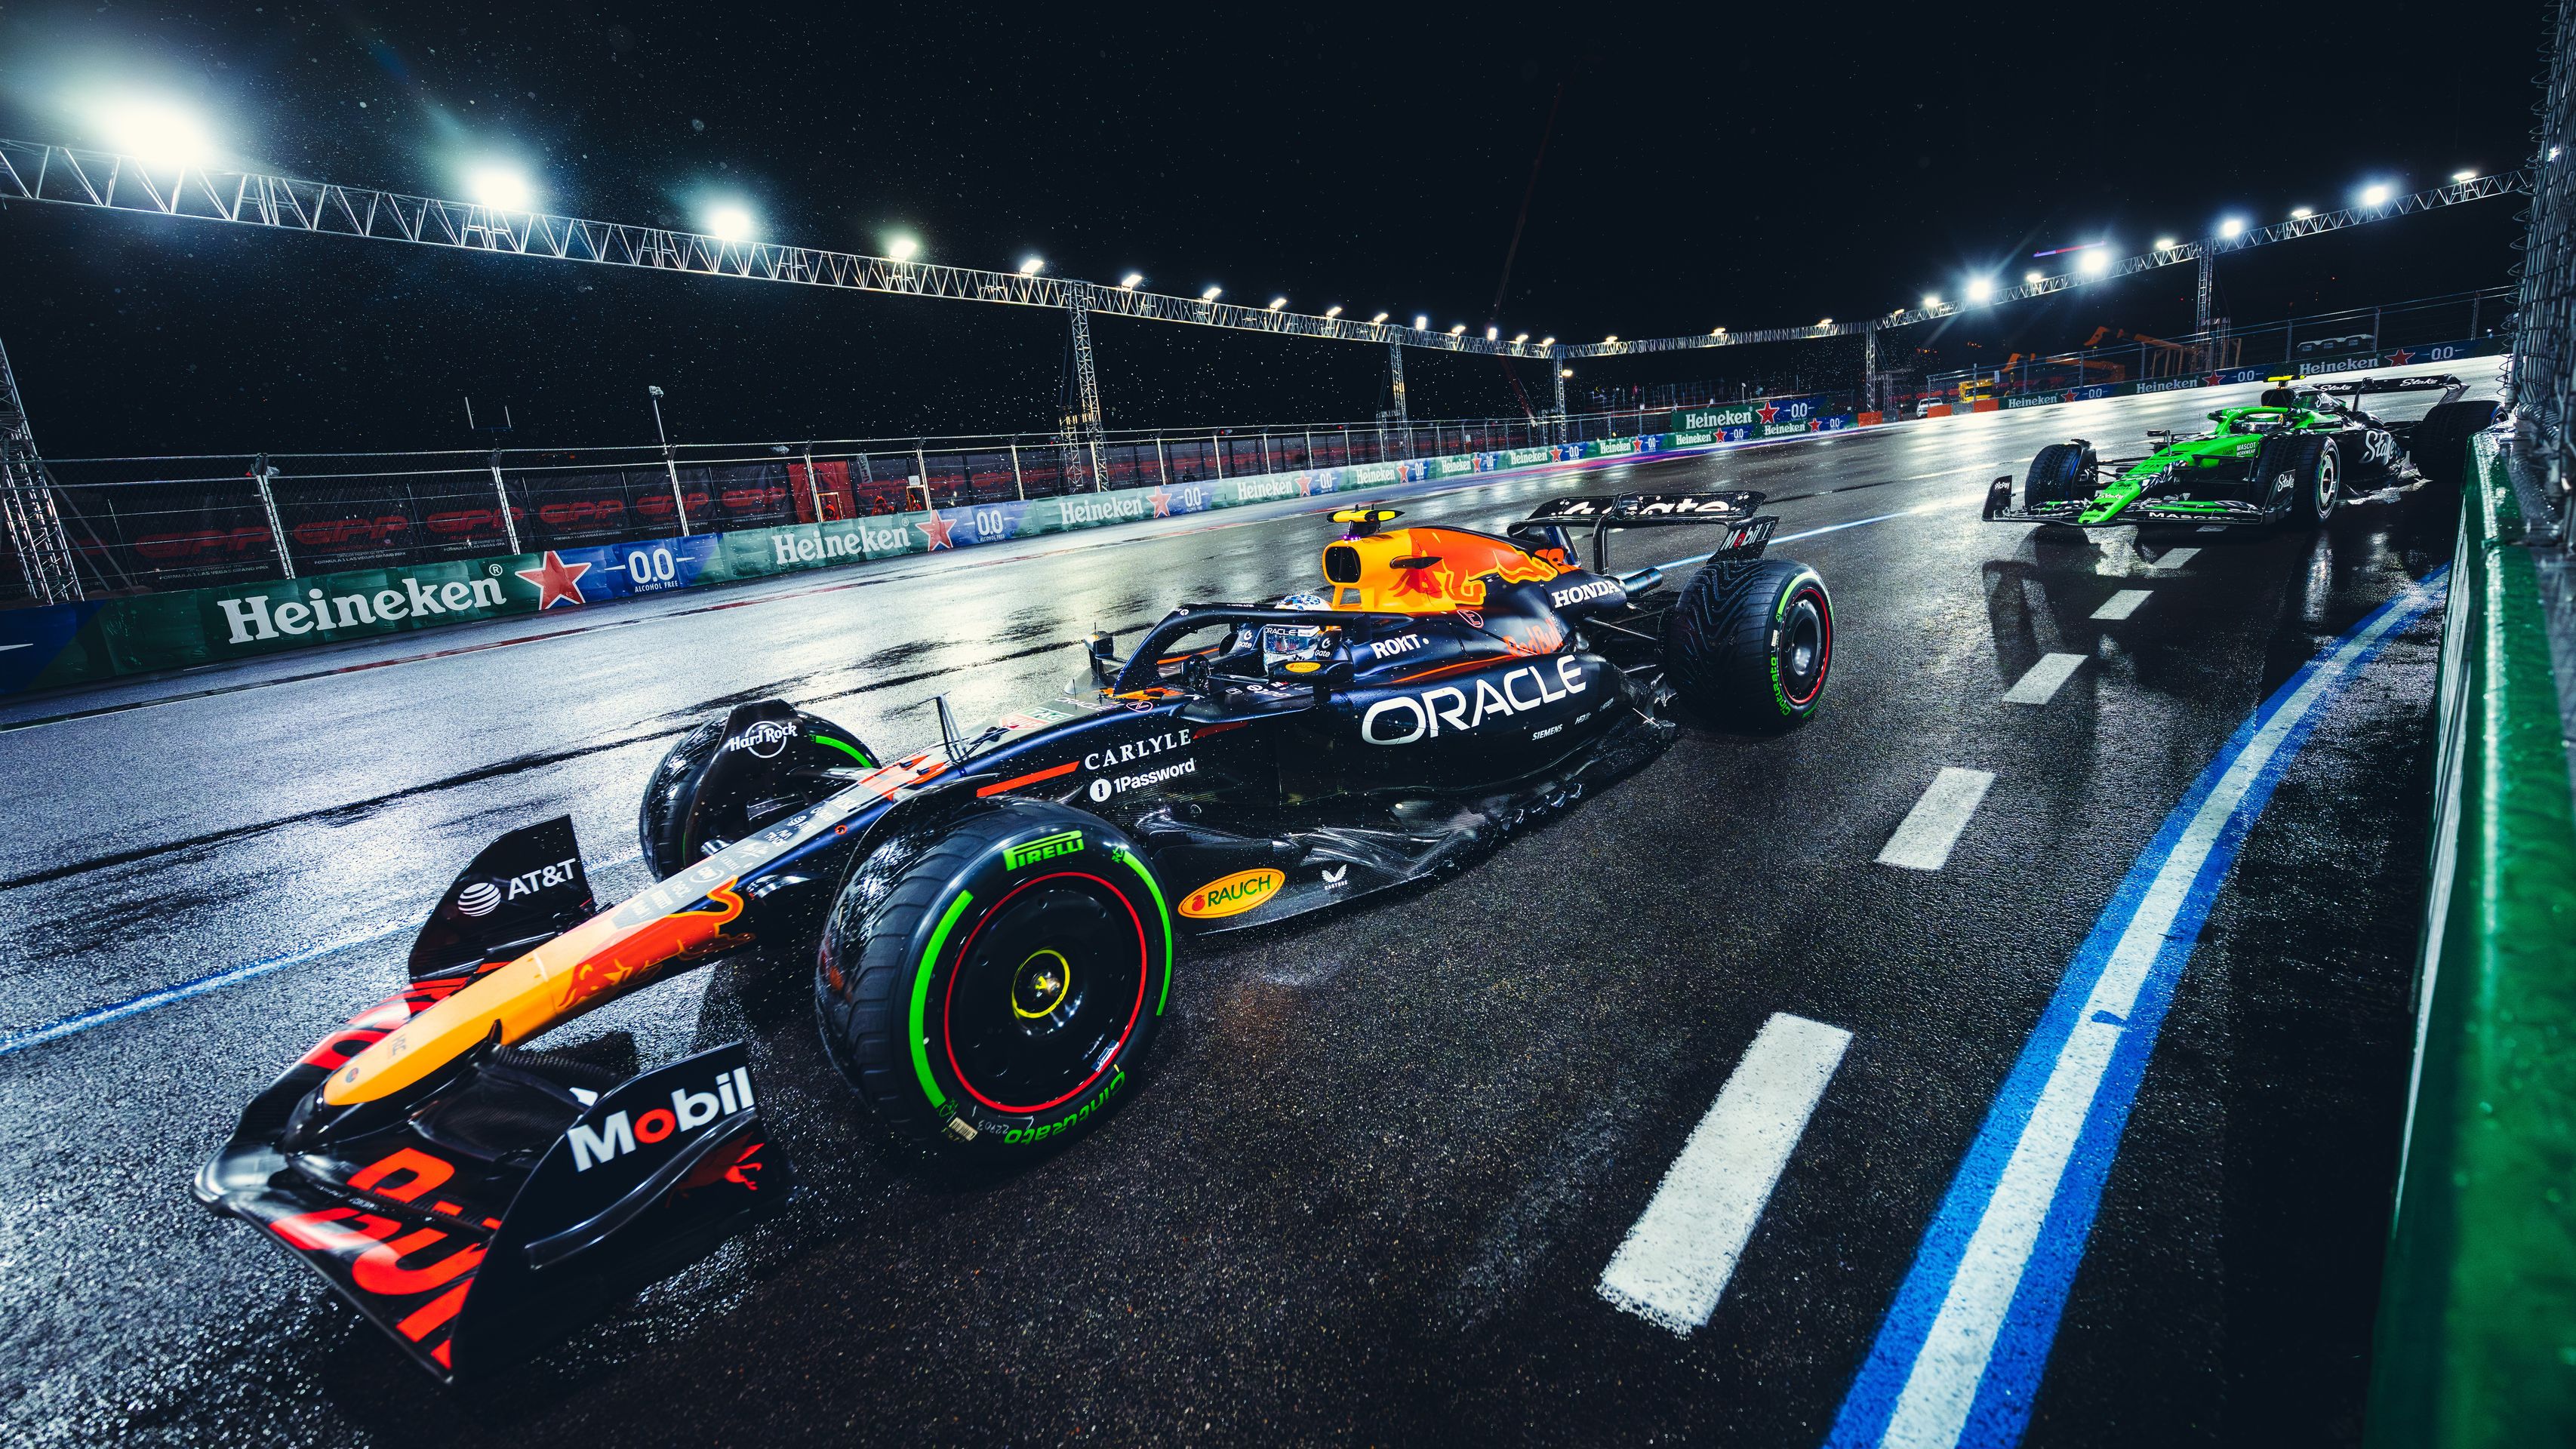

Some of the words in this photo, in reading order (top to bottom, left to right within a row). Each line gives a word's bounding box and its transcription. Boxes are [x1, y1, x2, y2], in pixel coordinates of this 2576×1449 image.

[2299, 357, 2379, 375] Heineken
[2136, 378, 2198, 393] Heineken
[2008, 395, 2057, 409] Heineken
[1685, 411, 1752, 429] Heineken
[1764, 423, 1805, 435] Heineken
[1600, 441, 1631, 454] Heineken
[1676, 432, 1711, 445] Heineken
[2236, 441, 2256, 451] MASCOT
[1442, 457, 1471, 474] Heineken
[1510, 450, 1547, 465] Heineken
[1236, 474, 1293, 500] Heineken
[1356, 465, 1395, 485] Heineken
[2278, 474, 2294, 492] Stake
[977, 510, 1003, 536] 0.0
[1060, 497, 1143, 525] Heineken
[771, 525, 911, 565] Heineken
[1721, 525, 1759, 551] Mobil
[628, 549, 675, 584] 0.0
[635, 583, 662, 592] ALCOHOL
[664, 580, 678, 589] FREE
[1551, 580, 1621, 608] HONDA
[217, 576, 506, 646] Heineken
[1264, 627, 1298, 636] ORACLE
[1362, 654, 1587, 745] ORACLE
[728, 731, 763, 752] Hard
[765, 722, 798, 743] Rock
[1531, 724, 1563, 740] SIEMENS
[1085, 728, 1192, 771] CARLYLE
[1114, 758, 1196, 794] 1Password
[1002, 829, 1085, 872] PIRELLI
[508, 857, 576, 900] AT&T
[1208, 874, 1271, 907] RAUCH
[566, 1066, 755, 1174] Mobil
